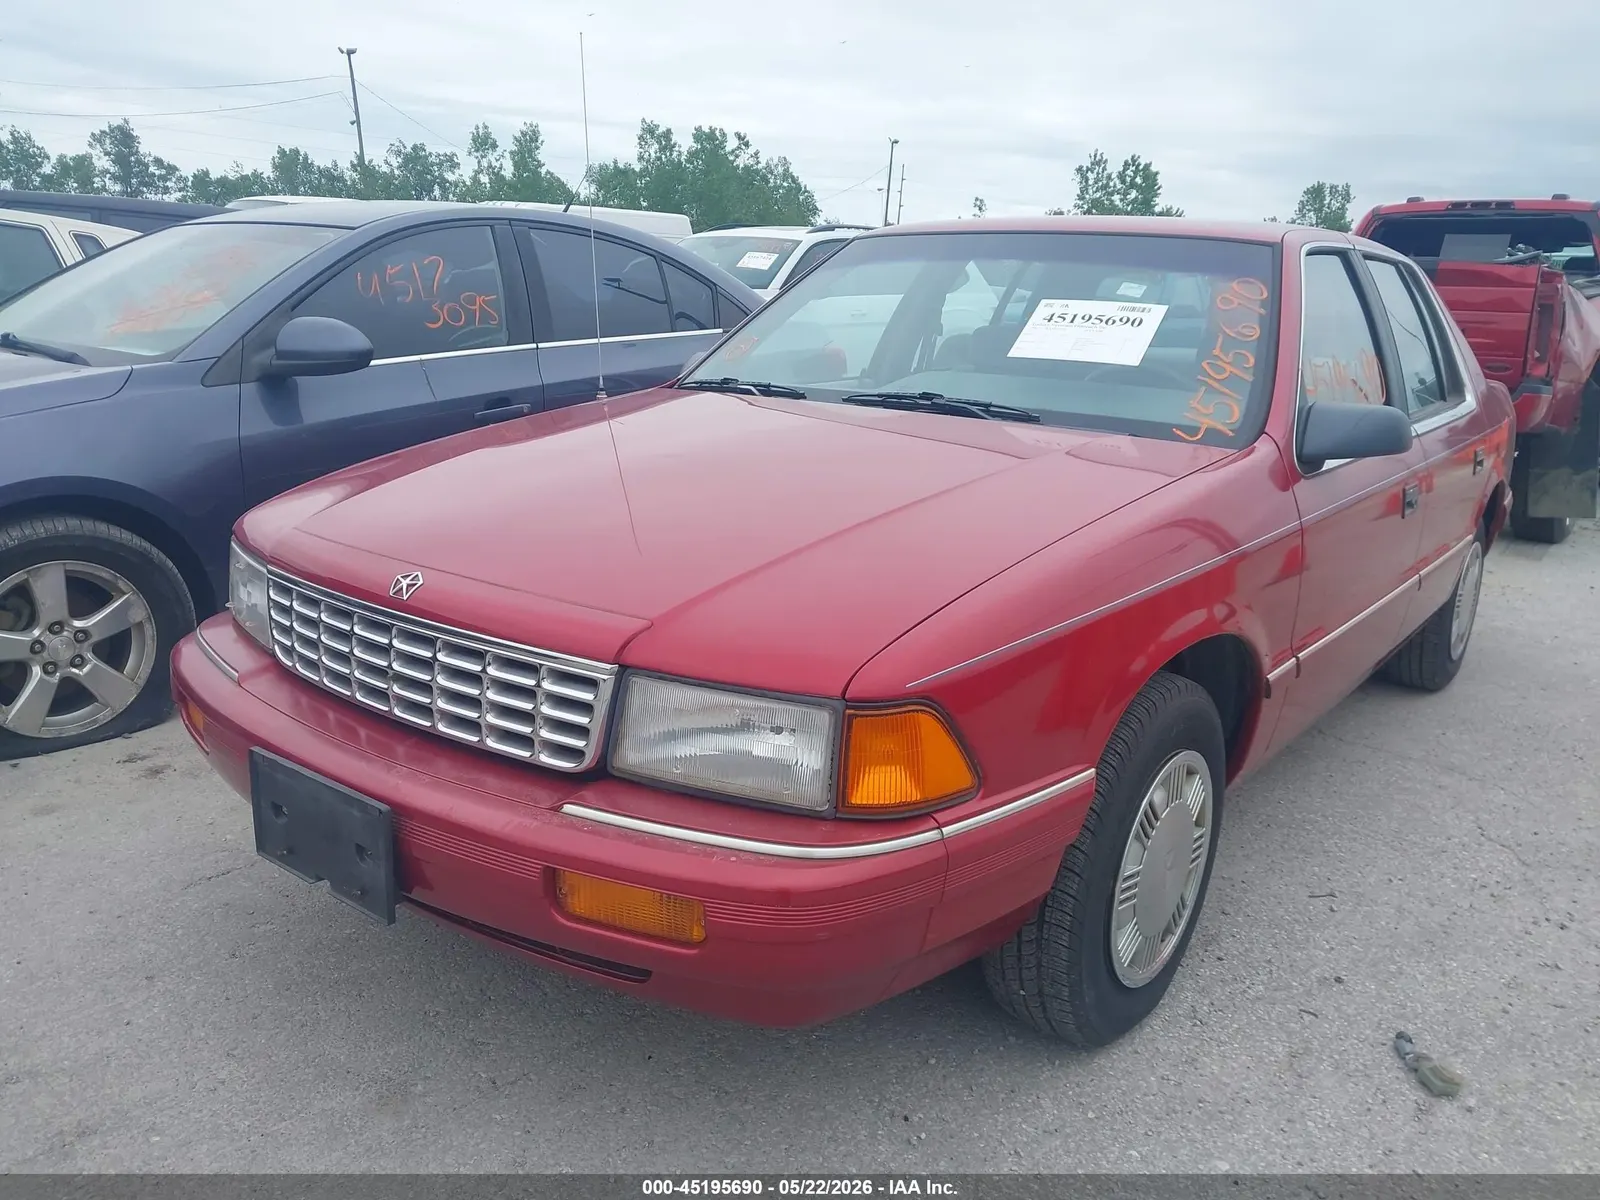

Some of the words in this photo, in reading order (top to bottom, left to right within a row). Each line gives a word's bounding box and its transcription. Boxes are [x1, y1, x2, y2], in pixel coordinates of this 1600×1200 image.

[357, 256, 443, 305] 4517
[424, 292, 499, 329] 3095
[1042, 312, 1144, 329] 45195690
[1172, 277, 1268, 441] 45195690
